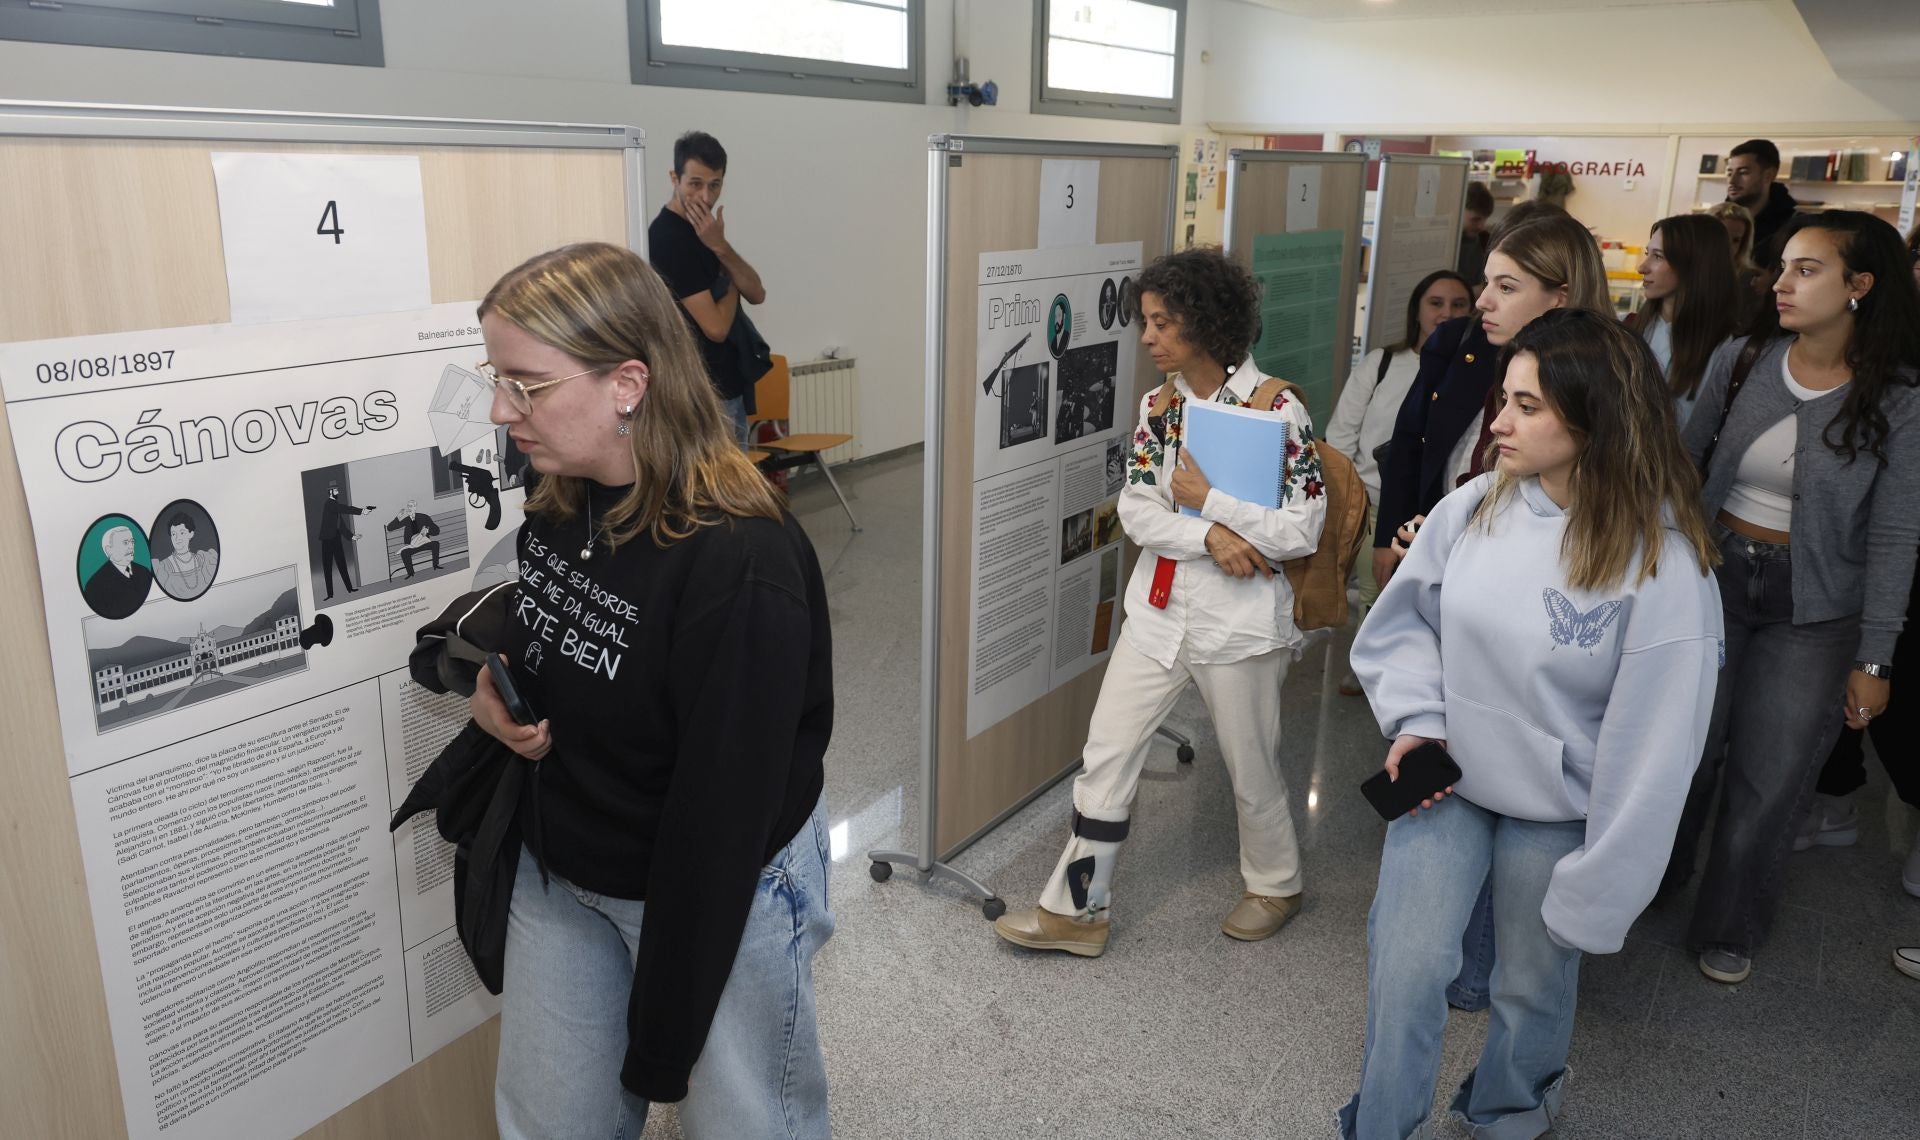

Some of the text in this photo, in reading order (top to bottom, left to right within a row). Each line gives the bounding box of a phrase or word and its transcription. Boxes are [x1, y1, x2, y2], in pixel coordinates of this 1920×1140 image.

[1066, 184, 1074, 209] 3
[1301, 184, 1308, 202] 2
[1502, 159, 1645, 177] REPROGRAFÍA
[316, 200, 344, 244] 4
[987, 264, 1022, 278] 27/12/1870
[418, 330, 454, 341] Balneario
[467, 327, 482, 335] San
[988, 294, 1041, 330] Prim
[36, 350, 176, 384] 08/08/1897
[55, 389, 399, 483] Cánovas
[528, 537, 547, 557] ES
[547, 553, 568, 576] QUE
[568, 571, 590, 595] SEA
[519, 560, 629, 648] QUE ME DA IGUAL
[560, 627, 621, 680] BIEN
[108, 796, 141, 812] acababa
[142, 791, 156, 800] con
[232, 756, 255, 768] librado
[309, 729, 331, 741] Europa
[135, 775, 147, 785] del
[194, 755, 209, 764] dice
[218, 745, 236, 758] placa
[256, 728, 286, 743] escultura
[287, 723, 301, 732] ante
[142, 783, 154, 792] fue
[163, 768, 195, 786] prototipo
[196, 763, 207, 772] del
[208, 751, 245, 768] magnicidio
[292, 725, 320, 739] vengador
[110, 807, 137, 822] mundo
[165, 793, 176, 802] He
[189, 784, 201, 794] por
[226, 770, 239, 779] soy
[249, 757, 275, 771] asesino
[112, 831, 122, 839] La
[123, 820, 152, 836] primera
[153, 810, 178, 823] oleada
[188, 798, 207, 810] ciclo)
[208, 794, 218, 803] del
[220, 782, 254, 799] terrorismo
[116, 838, 151, 856] Alejandro
[217, 808, 230, 817] con
[231, 804, 241, 812] los
[276, 778, 308, 794] atentando
[309, 771, 328, 782] contra
[328, 759, 357, 774] dirigentes
[192, 809, 206, 818] con
[206, 804, 217, 813] los
[218, 791, 252, 810] populistas
[253, 784, 272, 795] rusos
[312, 756, 346, 772] asesinando
[117, 852, 137, 866] (Sadi
[166, 832, 188, 846] Isabel
[262, 792, 294, 808] Humberto
[119, 863, 158, 882] Atentaban
[159, 853, 182, 866] contra
[238, 825, 253, 836] pero
[281, 806, 300, 817] contra
[329, 789, 338, 798] del
[339, 783, 356, 796] poder
[122, 873, 176, 899] Seleccionaban
[177, 867, 190, 876] sus
[222, 848, 238, 860] pero
[266, 824, 295, 840] actuaban
